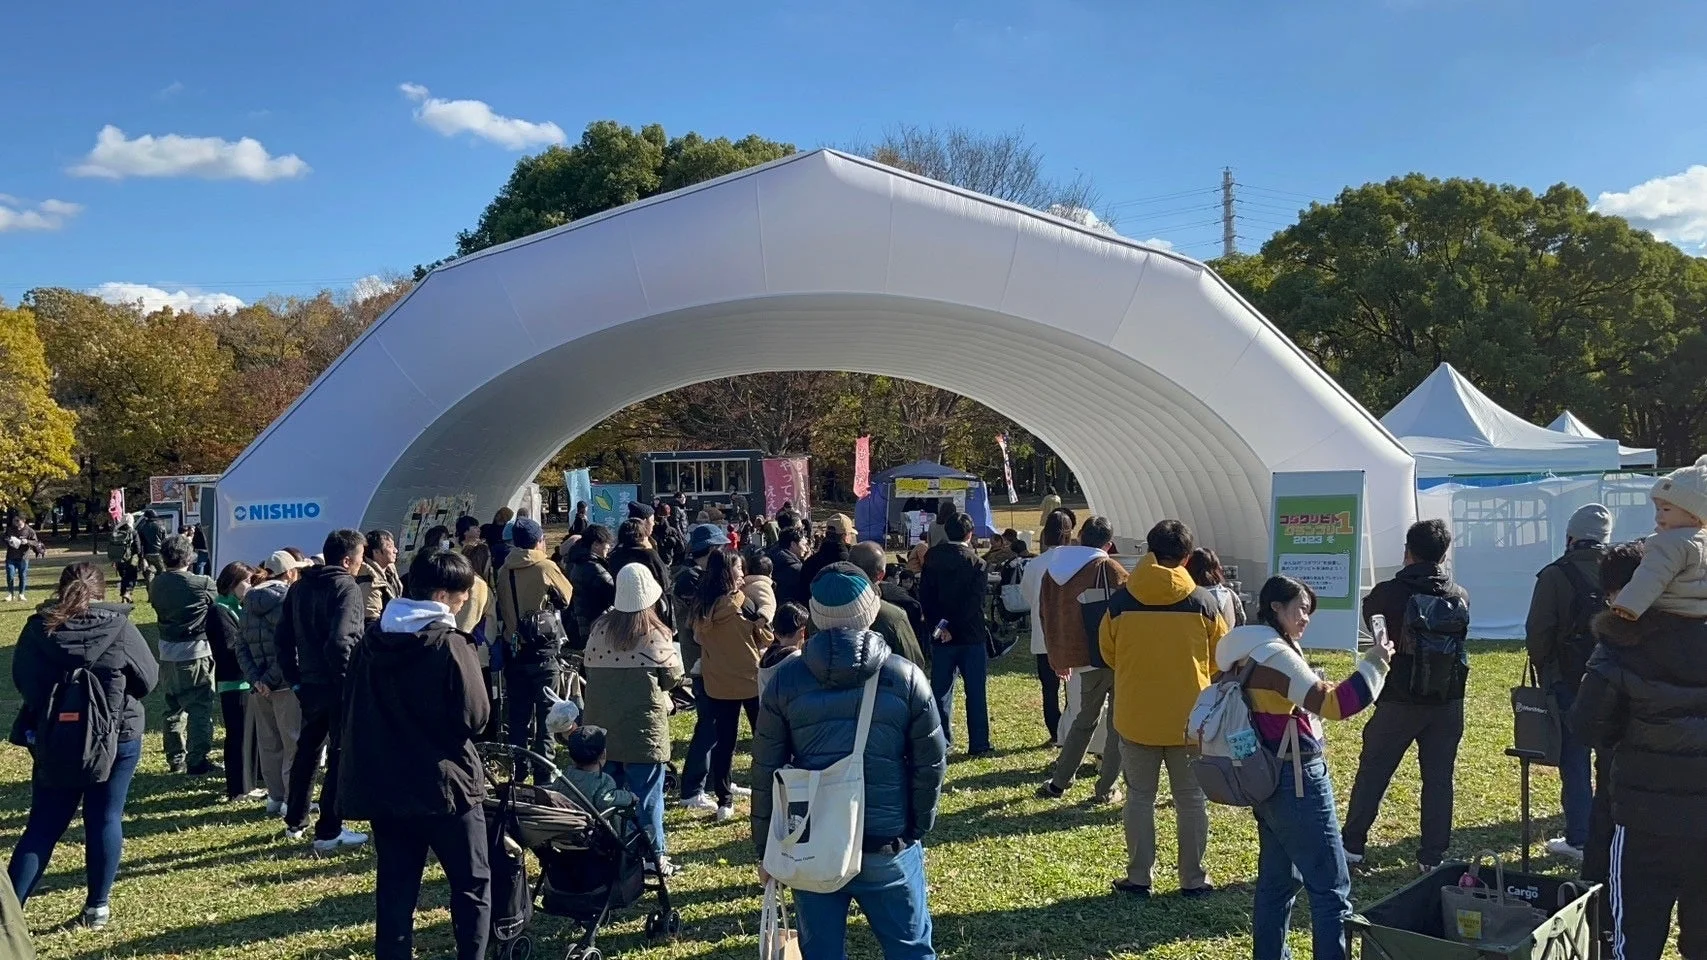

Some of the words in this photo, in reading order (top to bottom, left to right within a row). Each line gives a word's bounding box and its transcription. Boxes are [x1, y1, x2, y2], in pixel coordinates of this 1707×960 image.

[249, 503, 320, 520] NISHIO
[1293, 535, 1323, 544] 2023
[1507, 886, 1538, 899] Cargo
